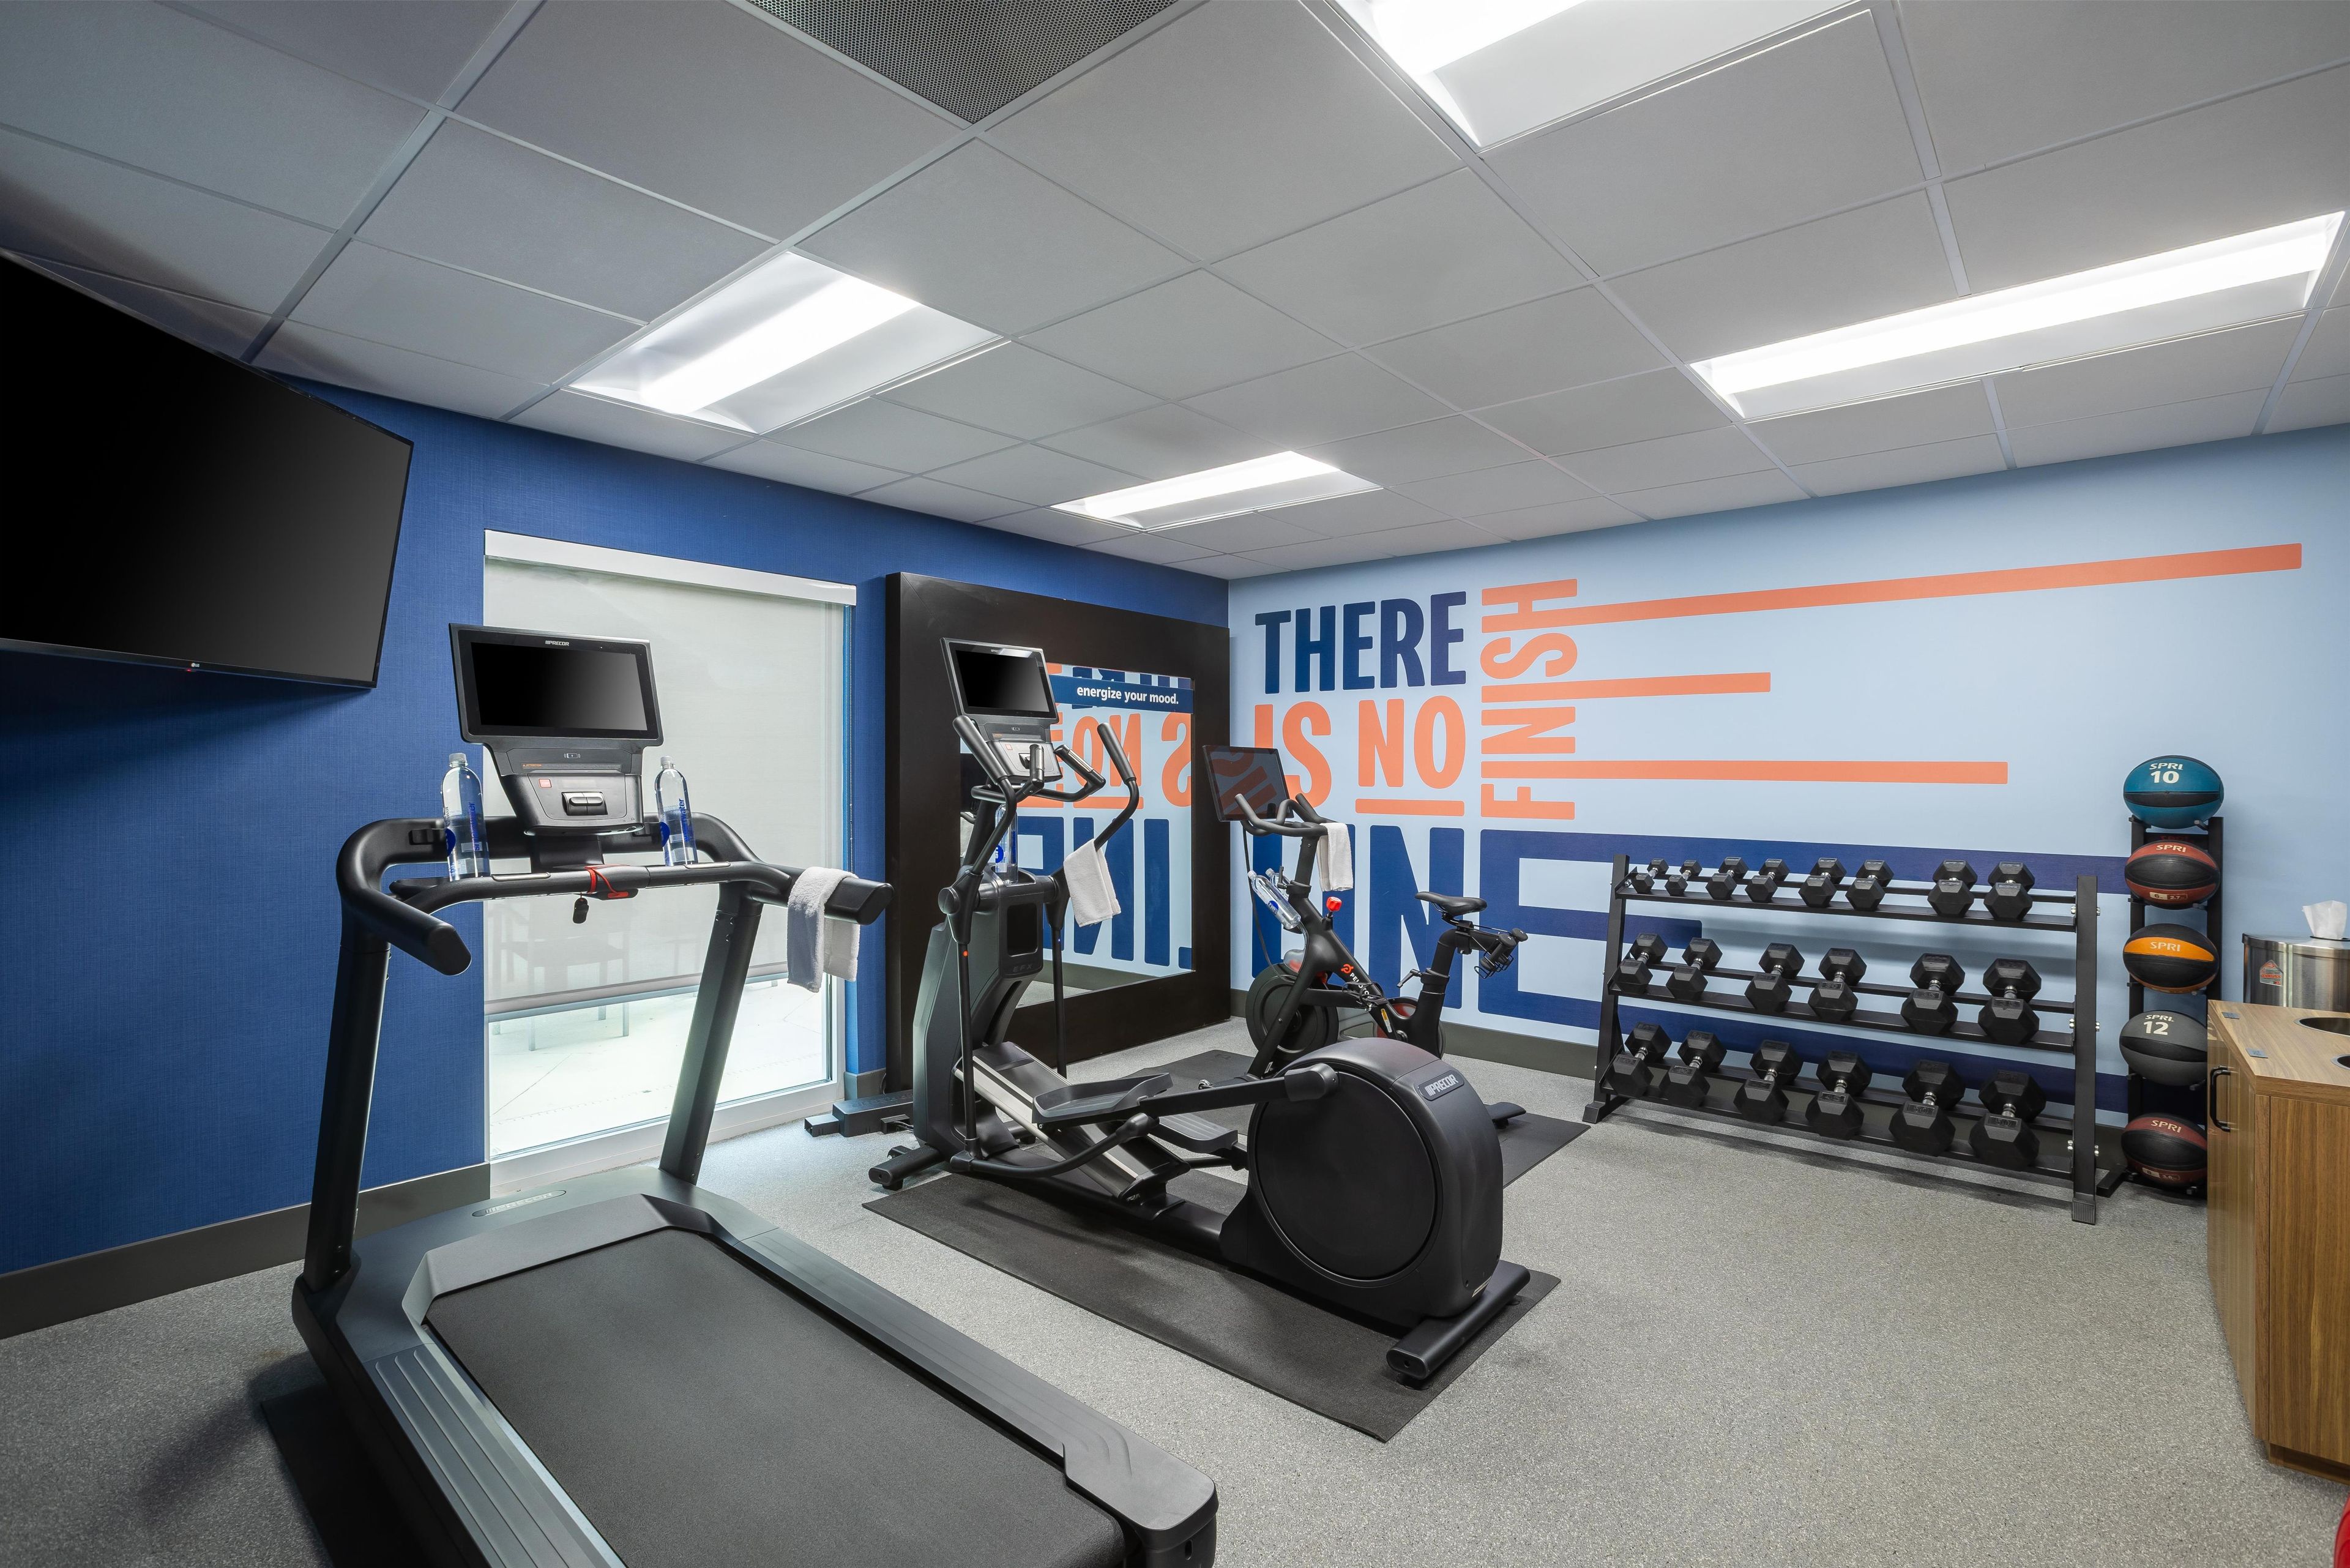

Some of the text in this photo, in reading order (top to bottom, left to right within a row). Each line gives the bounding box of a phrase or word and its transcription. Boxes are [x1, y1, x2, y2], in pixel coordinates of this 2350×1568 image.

[1255, 591, 1467, 694] THERE
[1076, 687, 1179, 704] energize your mood.
[1480, 578, 1578, 820] FINISH
[1357, 695, 1466, 789] NO
[2150, 771, 2179, 784] 10
[2150, 941, 2180, 952] SPRI
[2143, 1021, 2169, 1036] 12
[1430, 1074, 1459, 1095] PRECOR
[2150, 1120, 2182, 1133] SPRI
